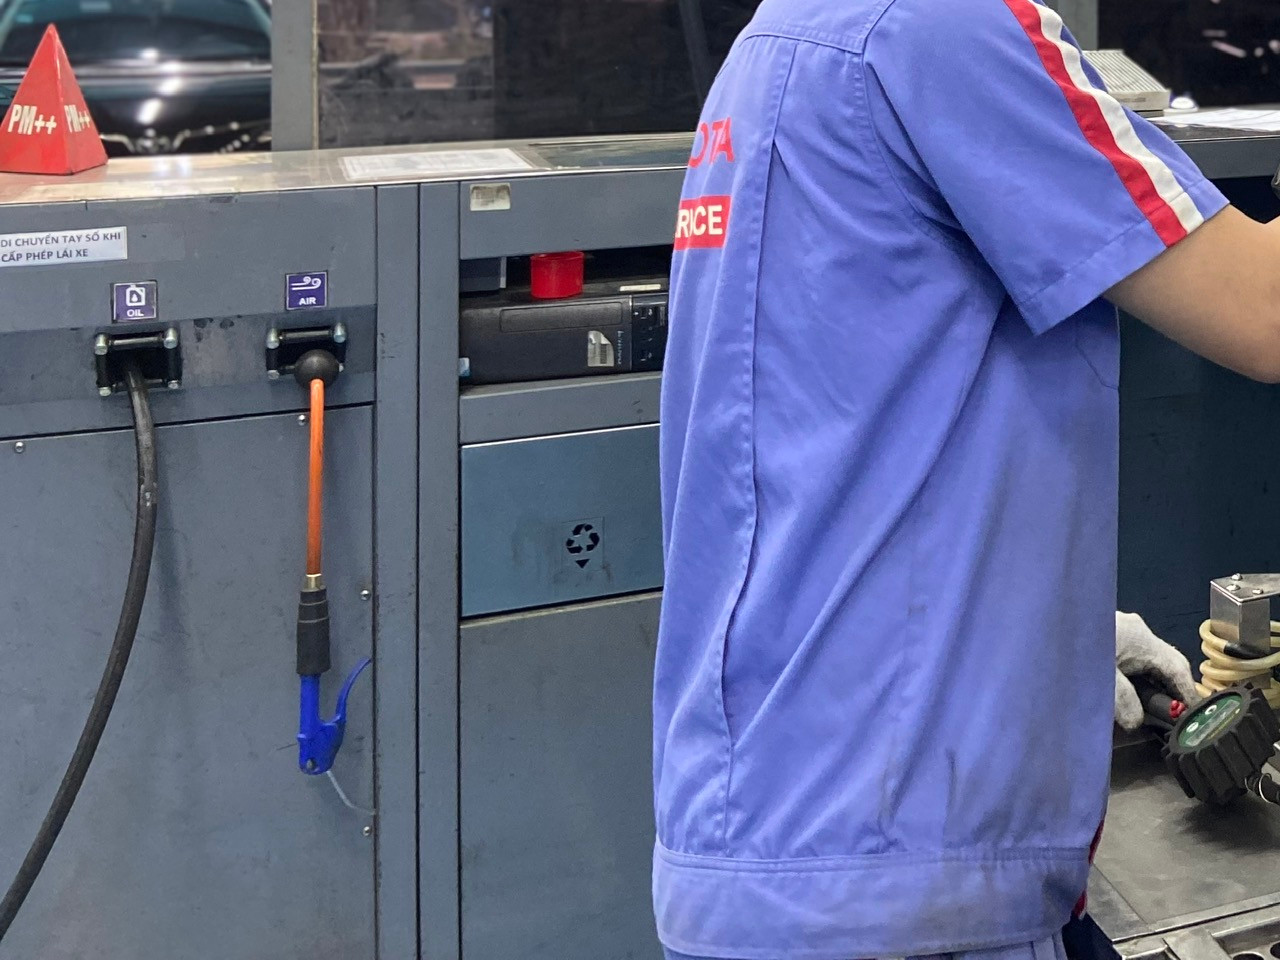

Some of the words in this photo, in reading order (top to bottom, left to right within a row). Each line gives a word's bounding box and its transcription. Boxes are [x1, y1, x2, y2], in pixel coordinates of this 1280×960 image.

[7, 104, 58, 136] PM++
[62, 234, 83, 245] TAY
[103, 231, 121, 241] KHI
[25, 249, 54, 261] PHÉP
[75, 248, 89, 258] XE
[298, 296, 317, 306] AIR
[126, 308, 145, 317] OIL
